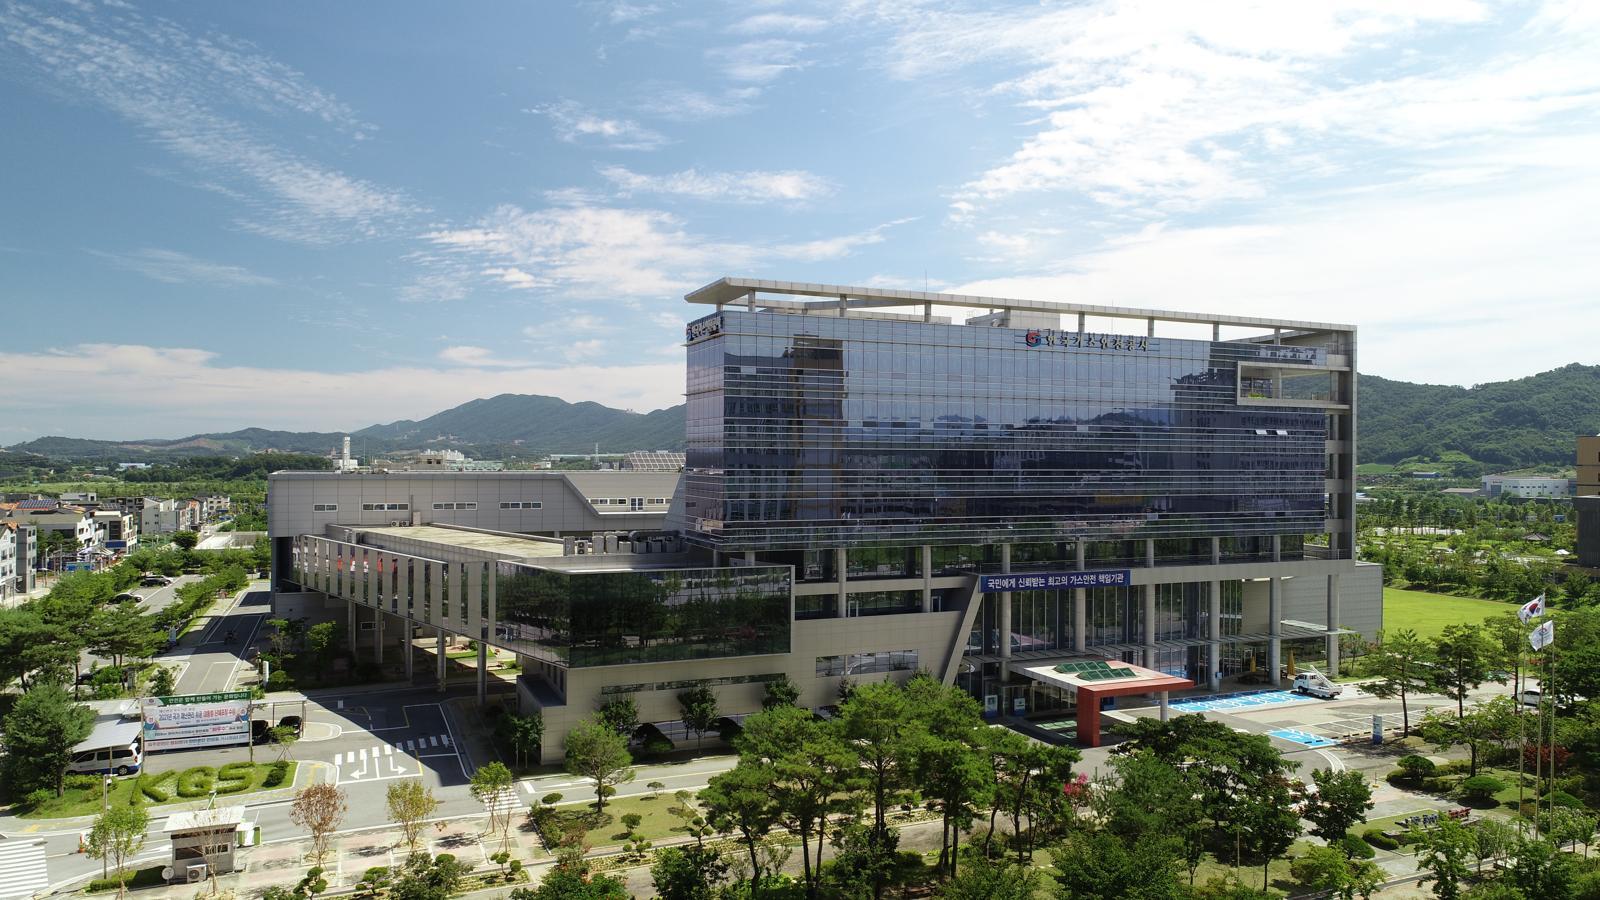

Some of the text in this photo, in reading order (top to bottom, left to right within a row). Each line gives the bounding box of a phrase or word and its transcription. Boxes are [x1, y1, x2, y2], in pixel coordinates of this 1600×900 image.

[987, 573, 1125, 589] 국민에게 신뢰받는 최고의 가스안전 책임기관
[131, 761, 256, 803] KGS
